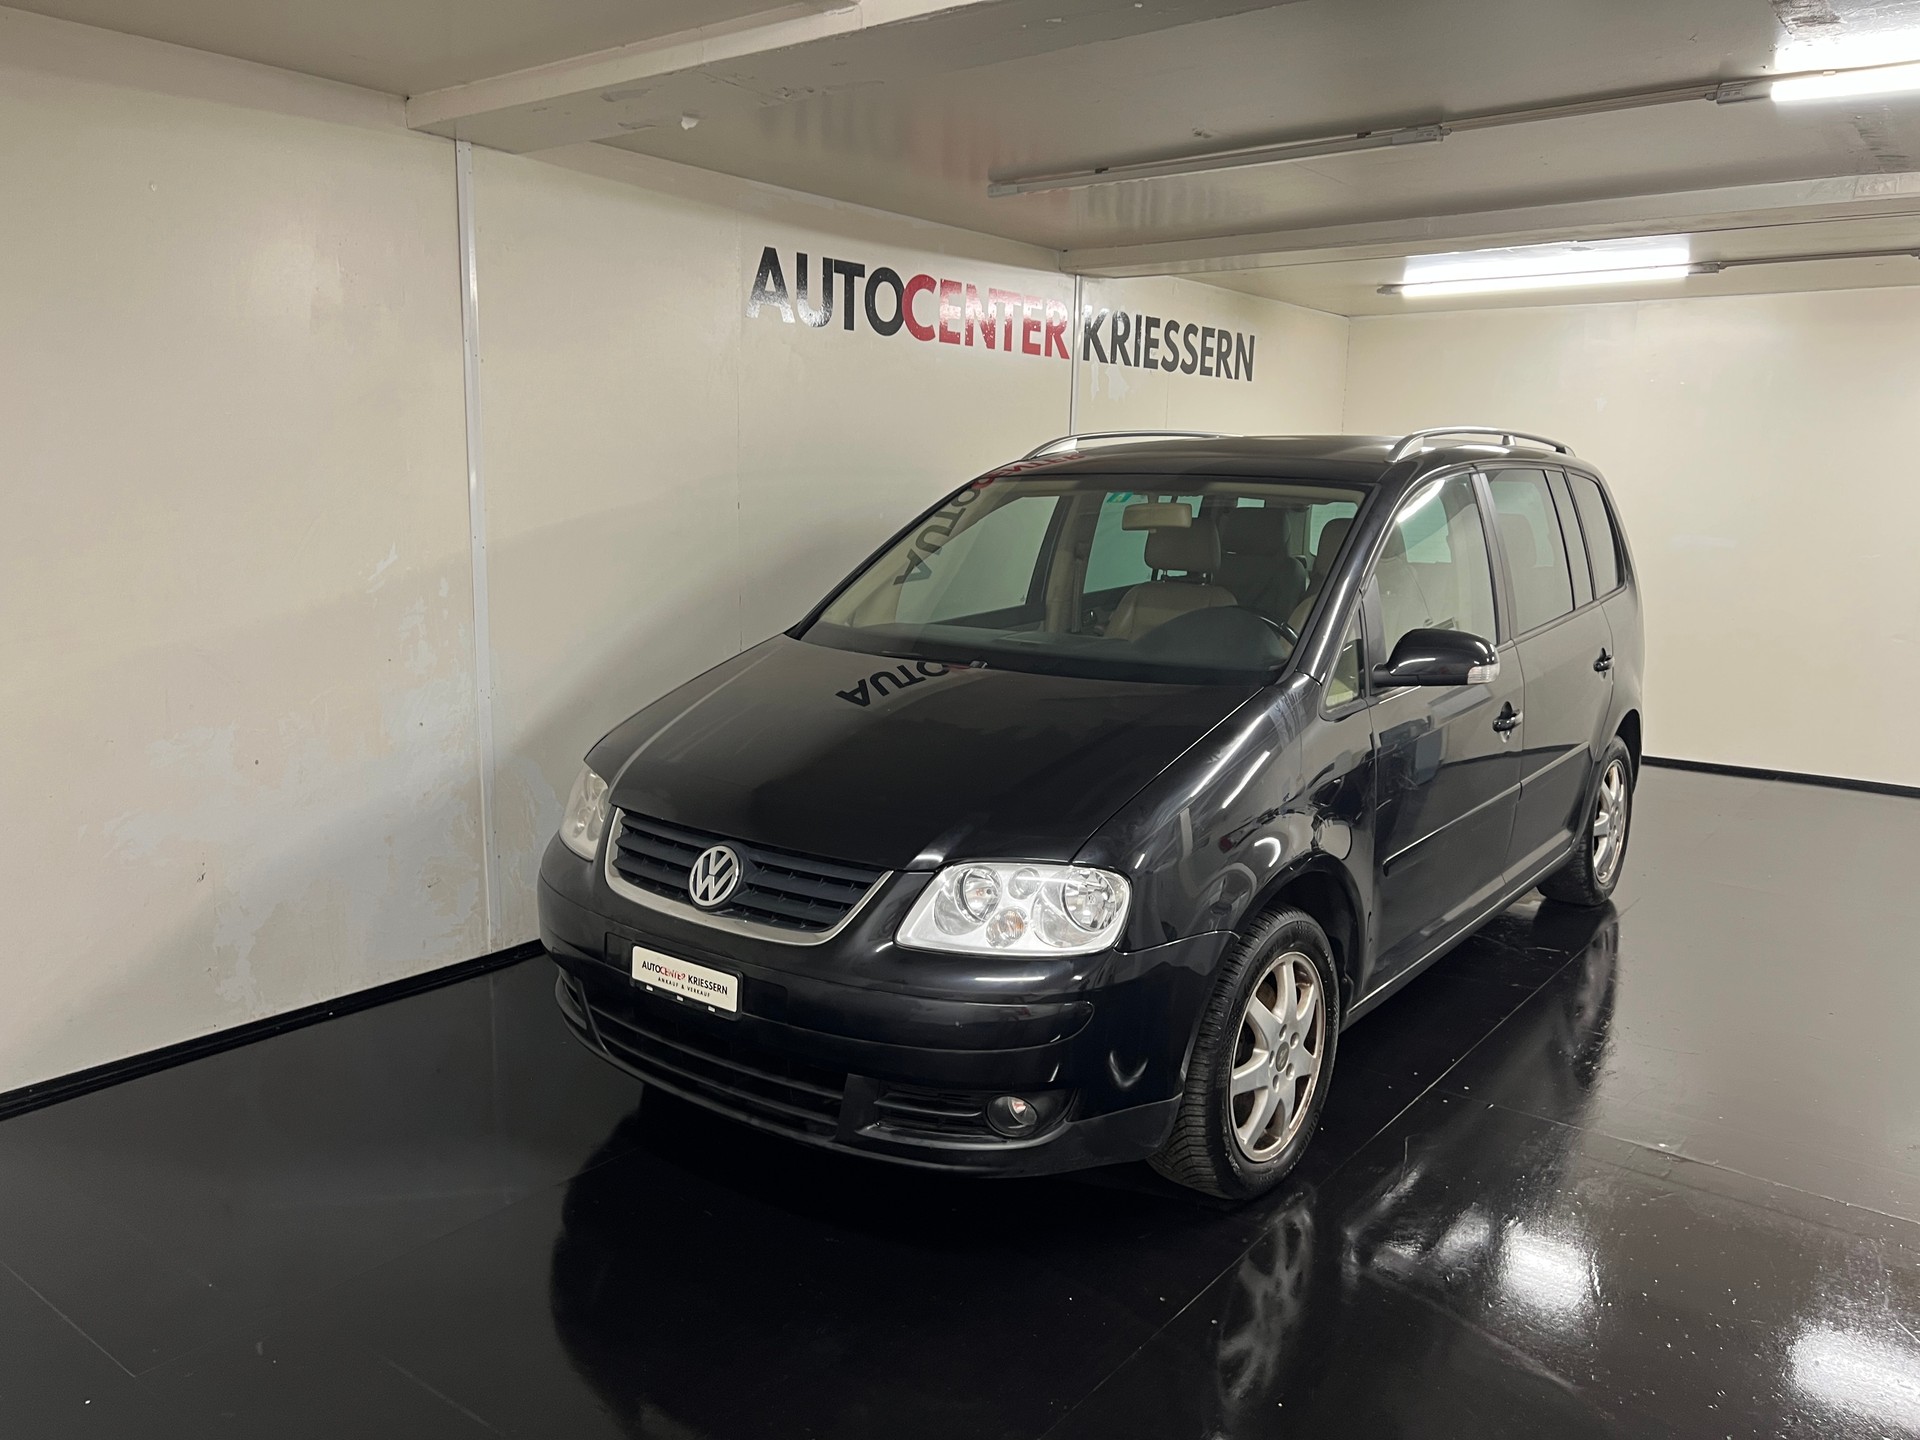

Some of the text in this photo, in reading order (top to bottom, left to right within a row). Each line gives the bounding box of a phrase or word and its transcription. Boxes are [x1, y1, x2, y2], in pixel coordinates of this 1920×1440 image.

[745, 246, 1255, 381] AUTOCENTER KRIESSERN
[690, 846, 739, 906] VW
[657, 976, 679, 988] ANKAUF
[687, 986, 711, 998] VERKAUF
[687, 974, 728, 996] KRIESSERN
